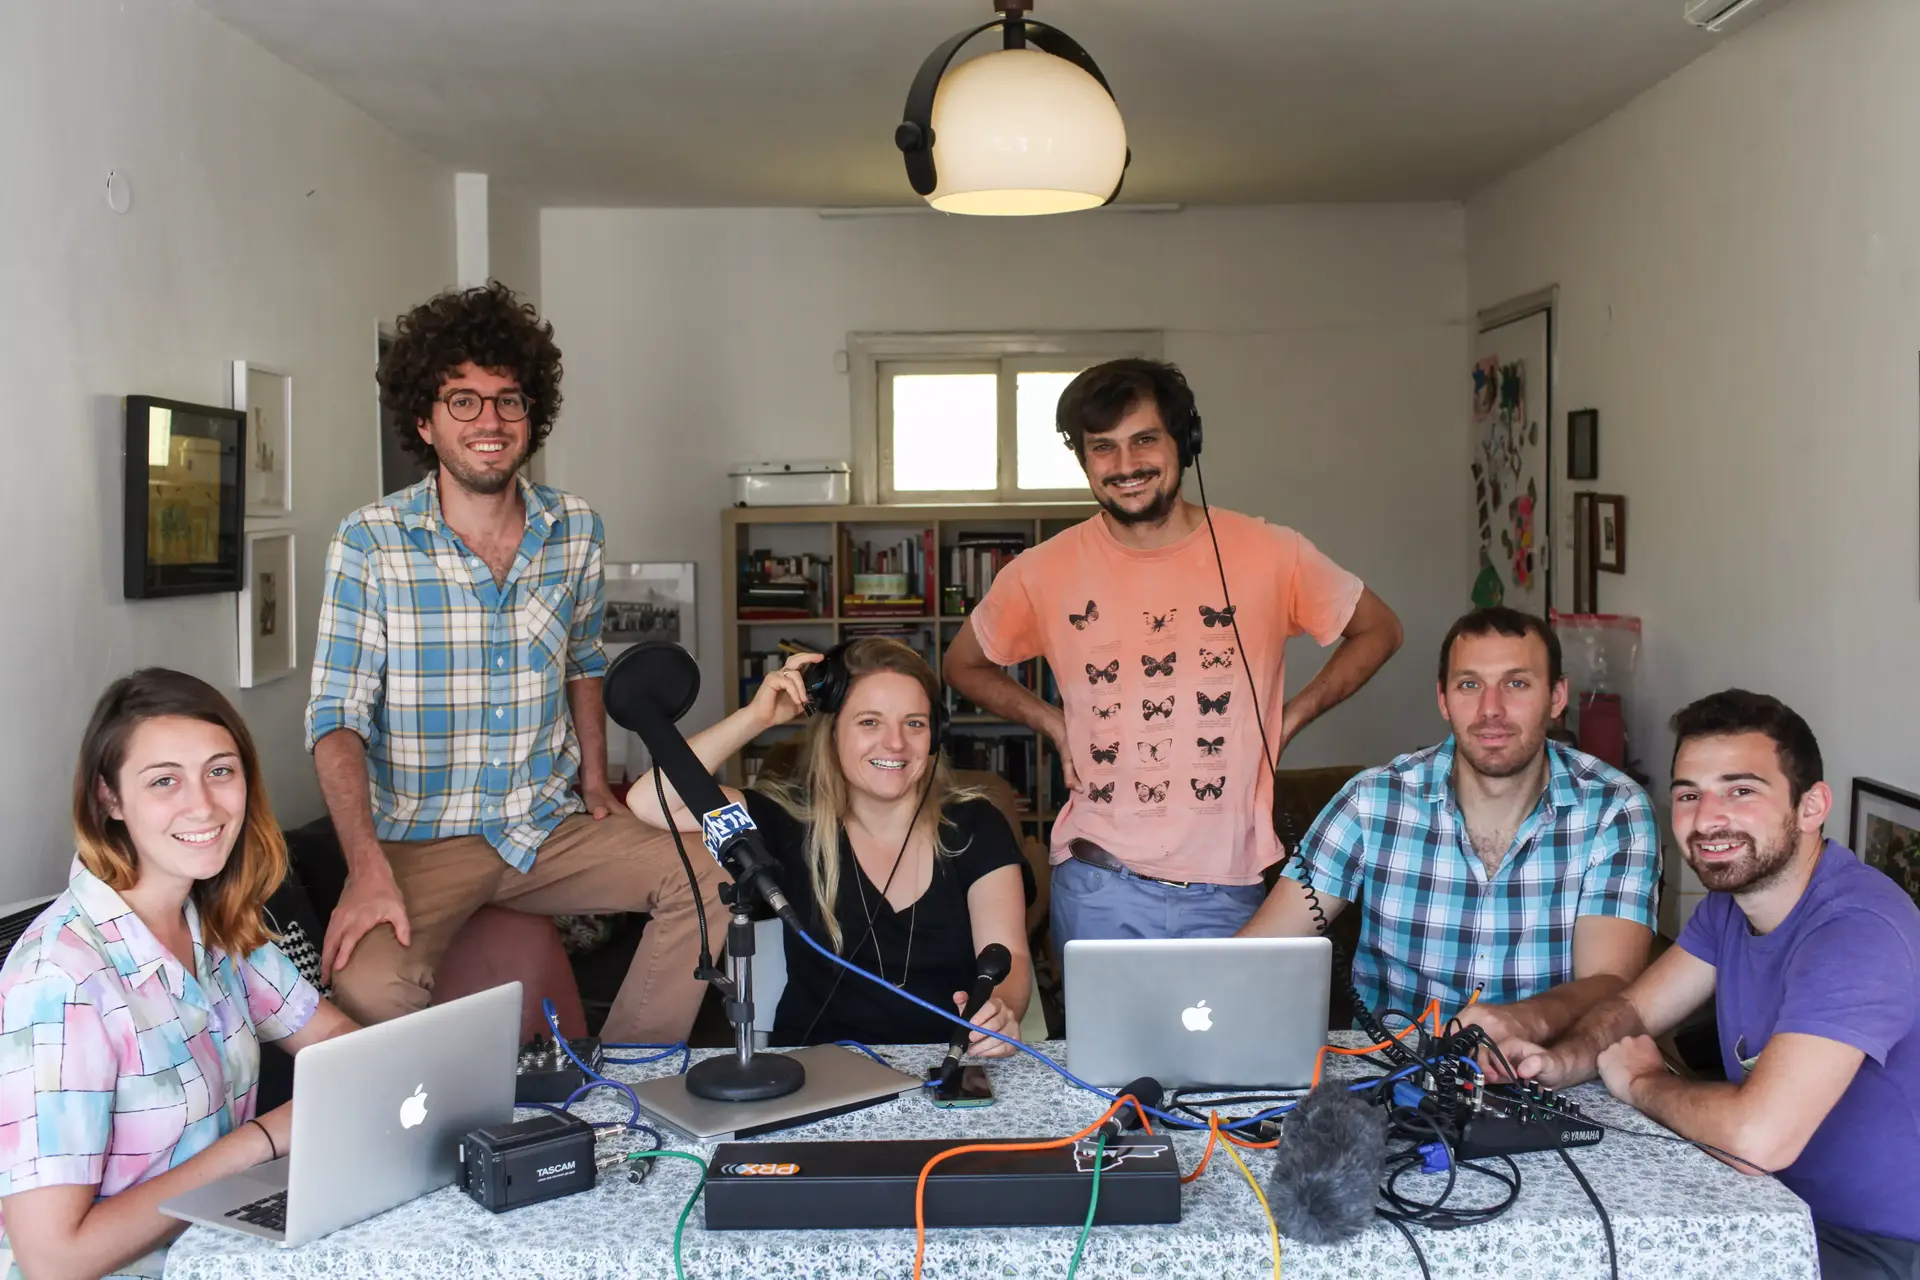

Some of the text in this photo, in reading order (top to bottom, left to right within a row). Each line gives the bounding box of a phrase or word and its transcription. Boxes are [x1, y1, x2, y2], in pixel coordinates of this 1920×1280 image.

[711, 810, 751, 836] גלצ
[1571, 1130, 1600, 1141] YAMAHA
[536, 1160, 576, 1177] TASCAM
[738, 1163, 797, 1175] PRX
